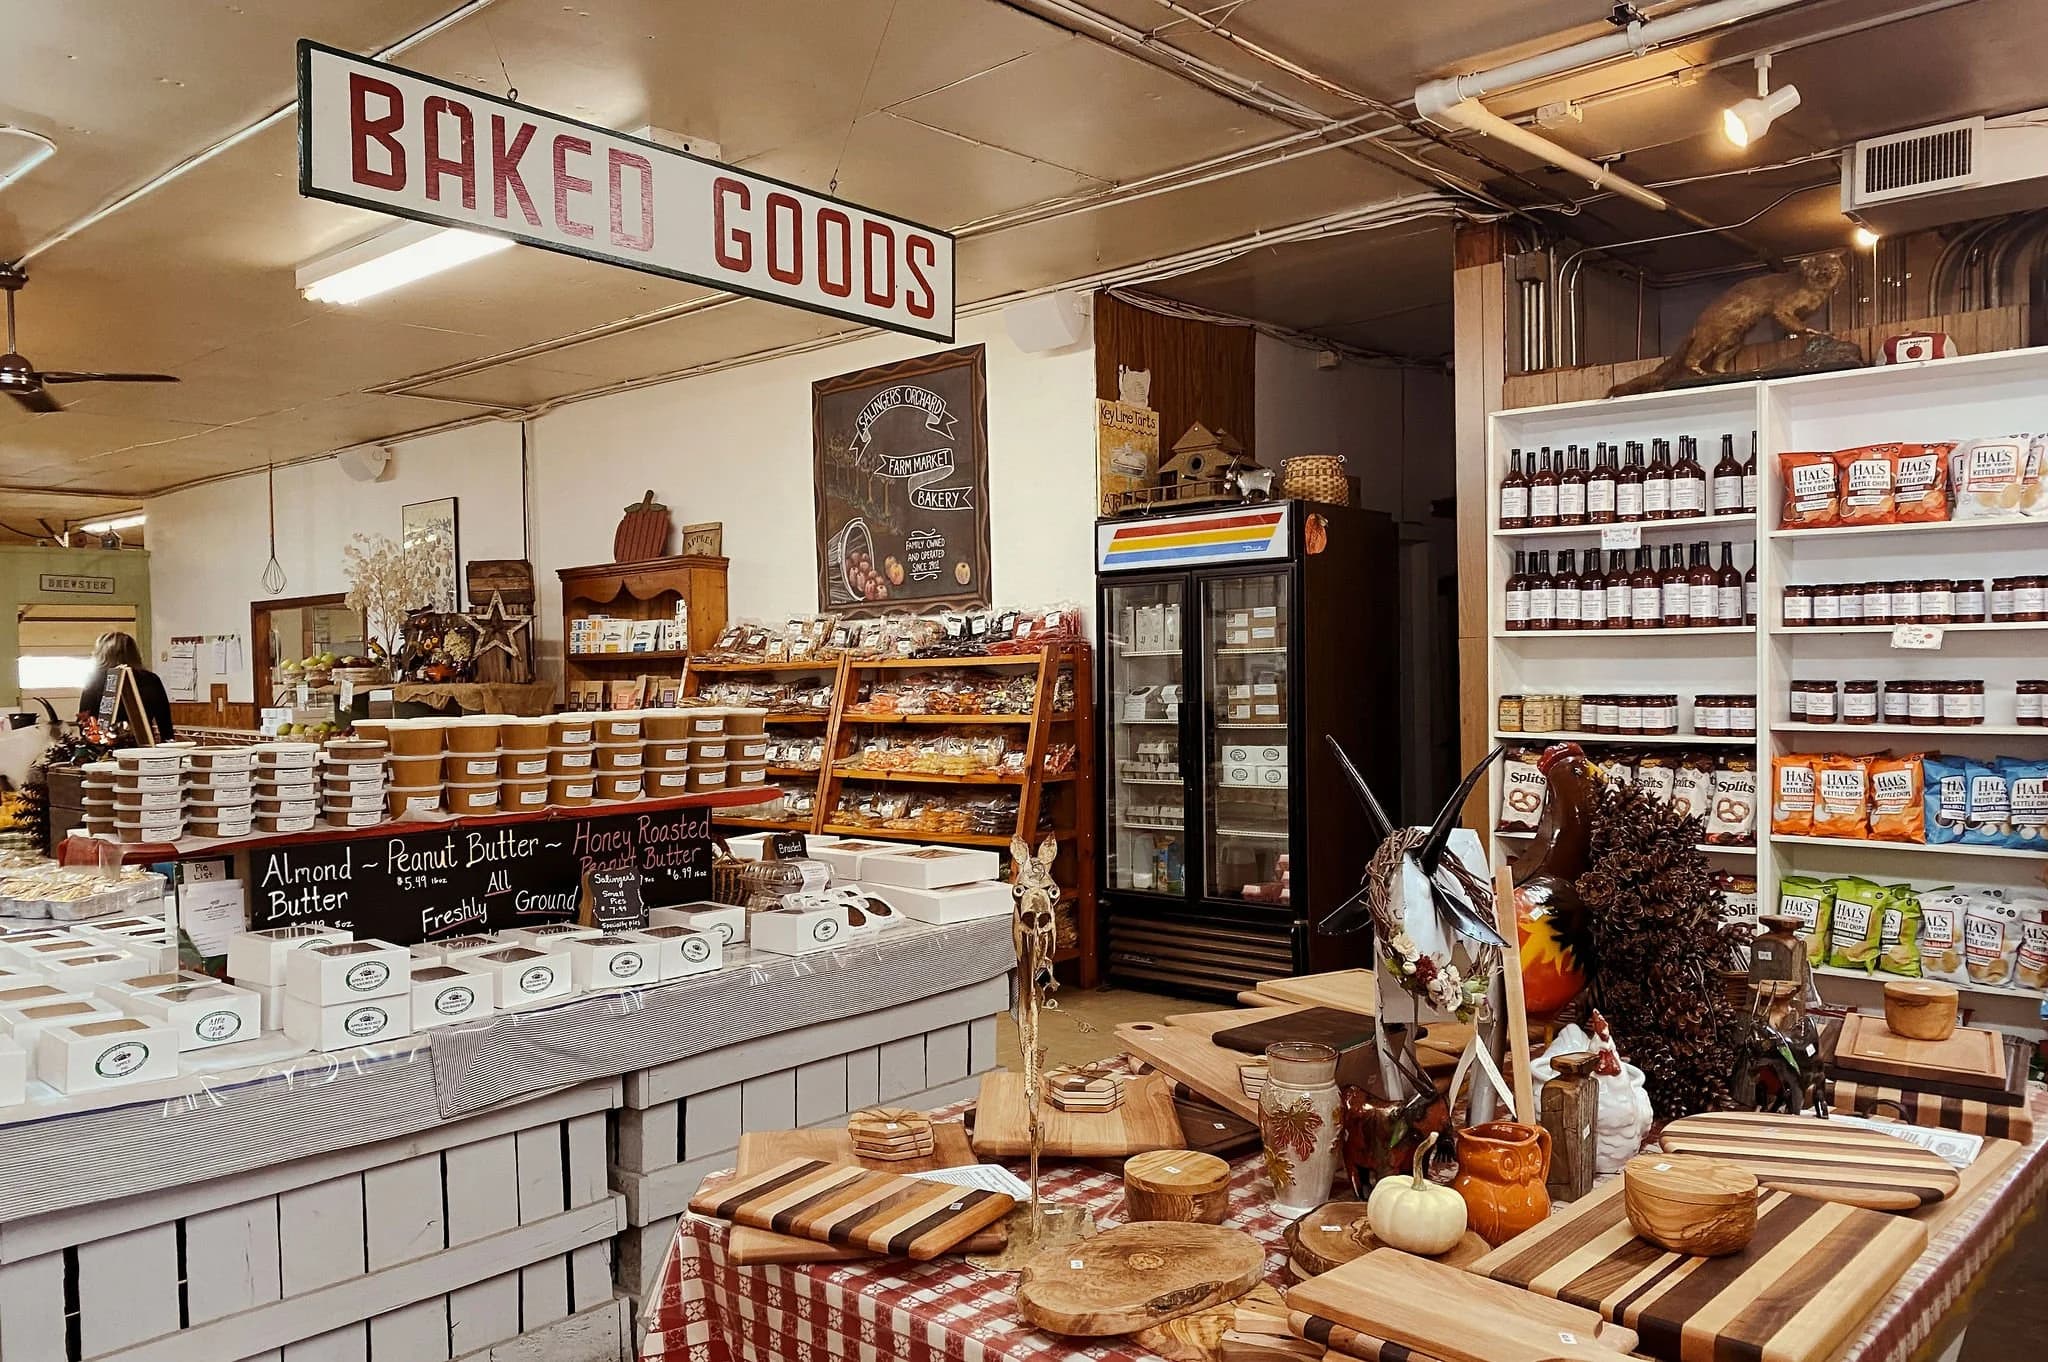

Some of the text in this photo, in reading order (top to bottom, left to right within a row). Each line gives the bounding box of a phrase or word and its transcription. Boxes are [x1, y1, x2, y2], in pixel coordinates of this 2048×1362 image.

[349, 71, 936, 320] BAKED GOODS
[905, 387, 942, 415] ORCHARD
[1101, 402, 1156, 429] Key Lime Tarts
[888, 450, 948, 475] FARM MARKET
[1977, 449, 2012, 463] HAL'S
[1853, 464, 1886, 476] HAL'S
[1900, 459, 1931, 472] HAL'S
[1798, 466, 1831, 482] HAL'S
[917, 491, 960, 508] BAKERY
[687, 534, 713, 550] APPLES
[905, 538, 946, 551] FAMILY OWNED
[908, 549, 945, 562] AND OPERATED
[912, 562, 927, 572] SINCE
[48, 578, 107, 590] BREWSTER
[1510, 771, 1546, 785] Splits
[1827, 773, 1859, 785] HAL'S
[1878, 774, 1907, 788] HAL'S
[1717, 781, 1756, 794] Splits
[572, 808, 711, 860] Honey Roasted
[388, 829, 539, 874] Peanut Butter
[642, 843, 702, 870] Butter
[195, 863, 209, 872] Pie
[261, 846, 352, 888] Almond
[193, 871, 213, 881] List
[487, 869, 512, 893] All
[602, 890, 625, 898] Small
[266, 886, 349, 921] Butter
[421, 885, 579, 934] Freshly Ground
[1729, 903, 1757, 917] Spli
[1784, 899, 1814, 913] HAL'S
[1837, 903, 1866, 920] HAL'S
[1927, 915, 1948, 927] AL'S
